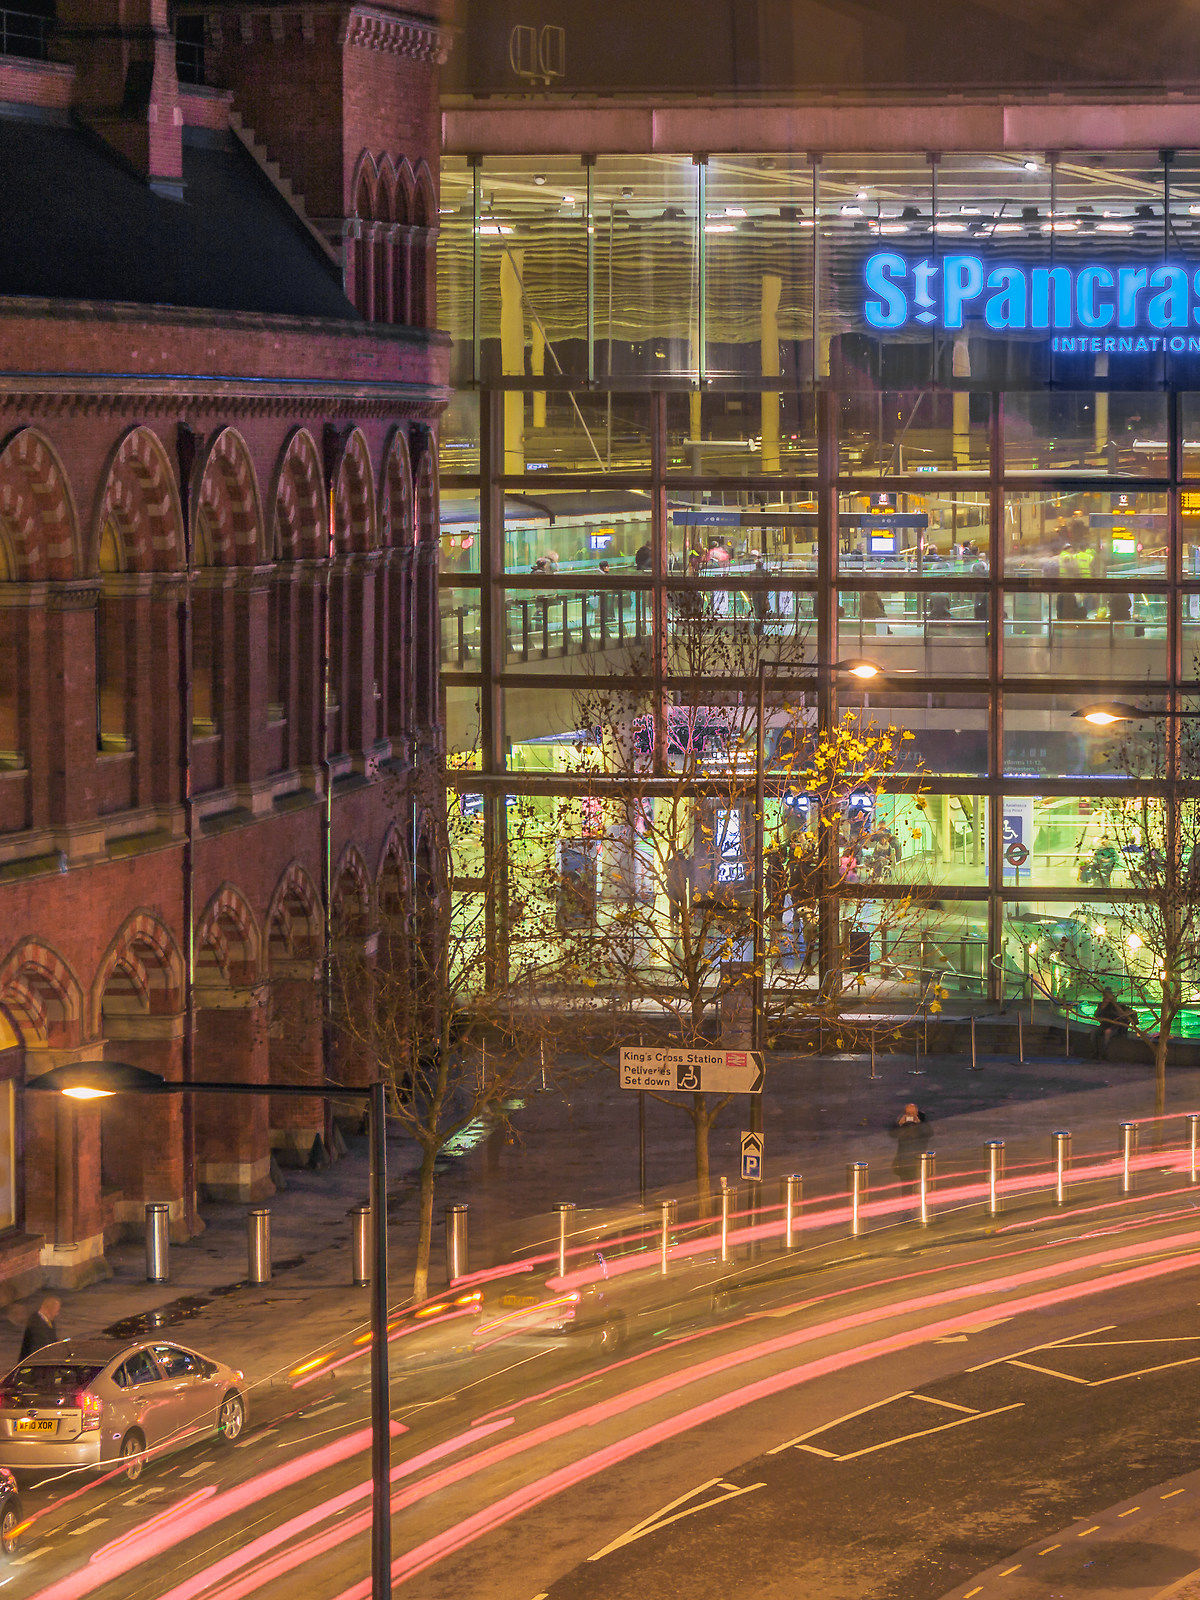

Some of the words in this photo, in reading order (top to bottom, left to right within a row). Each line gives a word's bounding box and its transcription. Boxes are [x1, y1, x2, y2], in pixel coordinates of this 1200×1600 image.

[624, 1052, 652, 1062] King's
[655, 1053, 683, 1062] Cross
[687, 1053, 723, 1064] Station
[624, 1065, 671, 1076] Deliveries
[625, 1076, 642, 1085] Set
[644, 1076, 670, 1086] down
[746, 1156, 758, 1174] P
[38, 1421, 53, 1430] XOR
